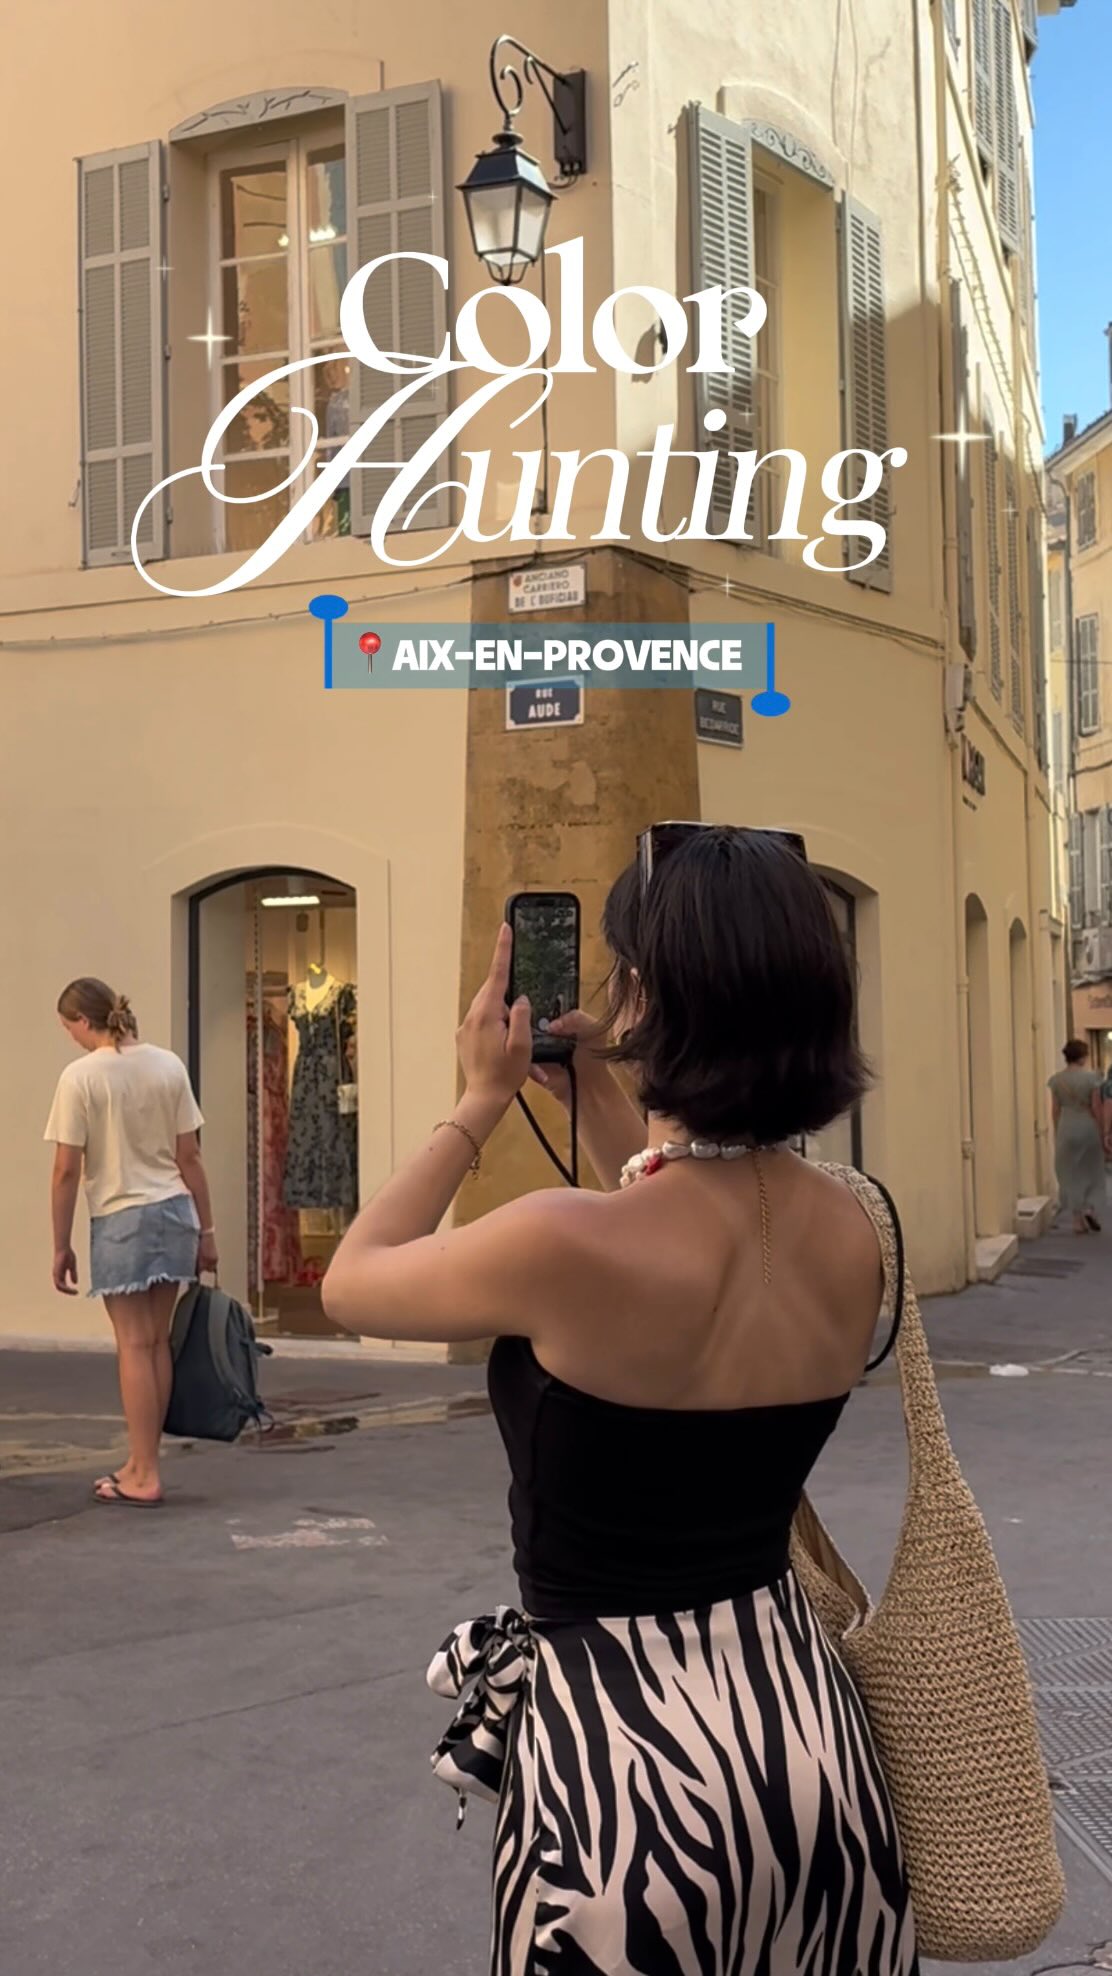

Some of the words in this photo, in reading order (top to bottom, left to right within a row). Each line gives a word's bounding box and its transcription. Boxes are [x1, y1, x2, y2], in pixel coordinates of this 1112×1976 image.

[524, 569, 570, 583] ANCIANO
[535, 687, 553, 699] RUE
[528, 702, 561, 719] AUDE
